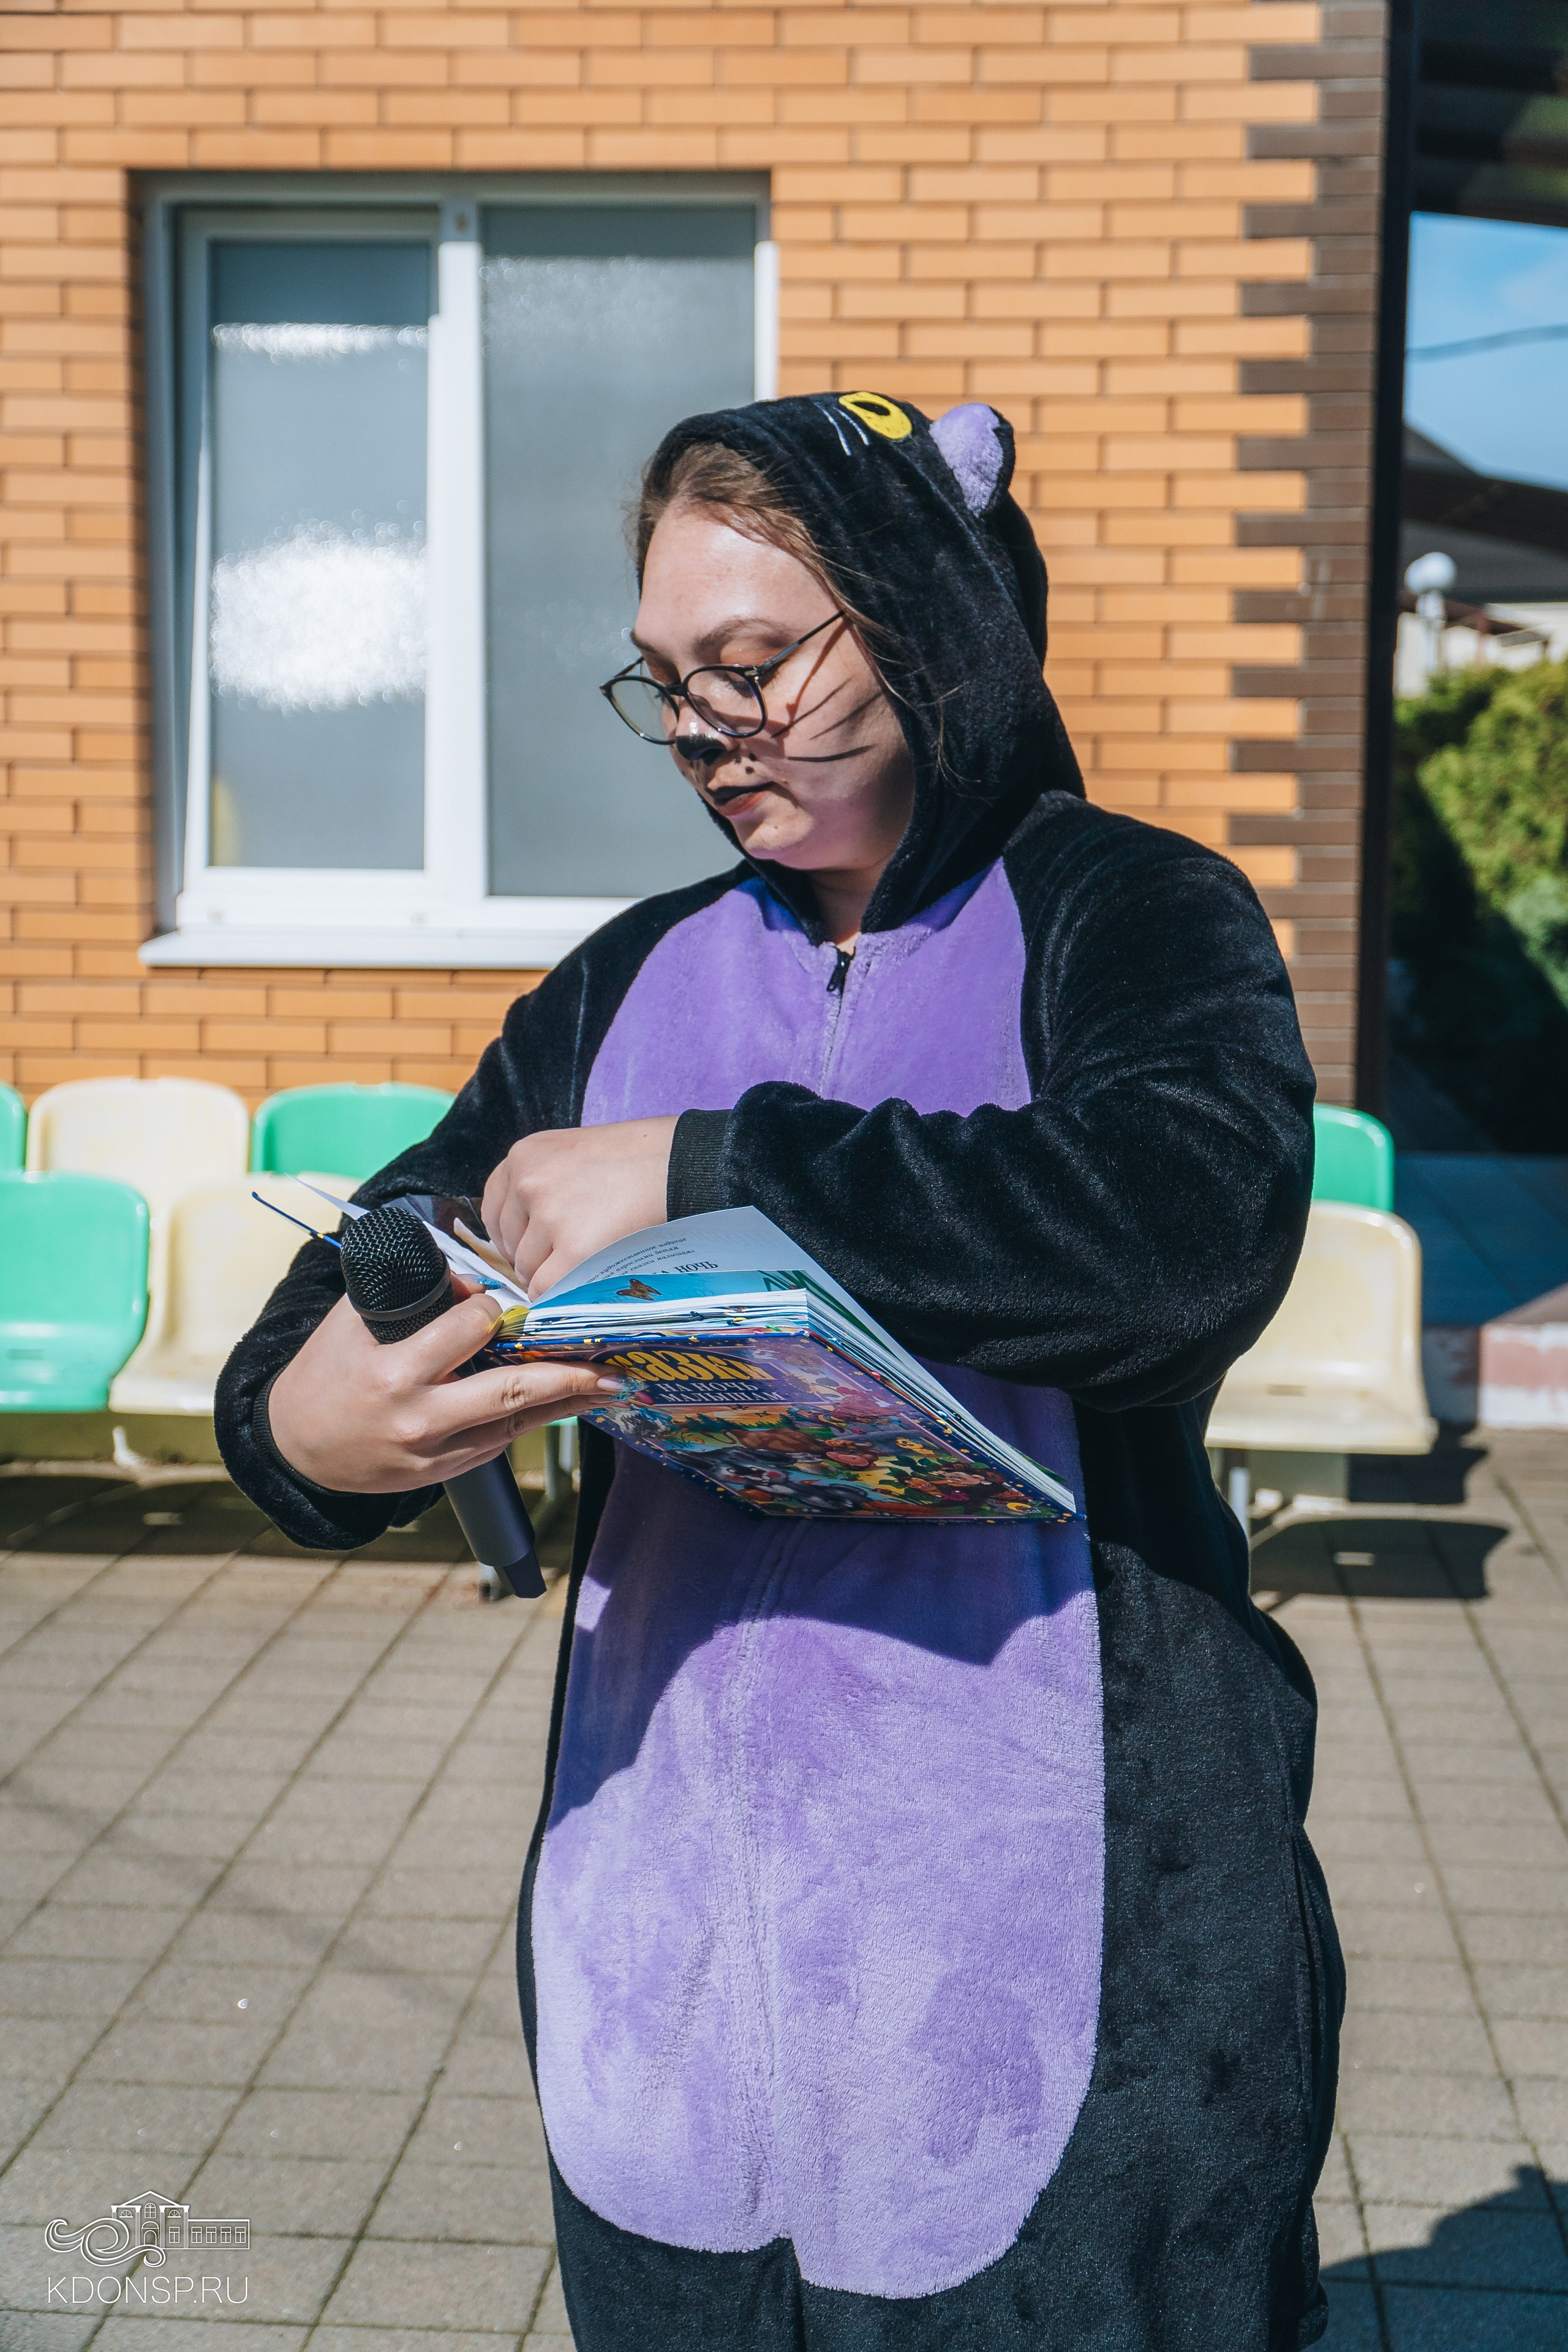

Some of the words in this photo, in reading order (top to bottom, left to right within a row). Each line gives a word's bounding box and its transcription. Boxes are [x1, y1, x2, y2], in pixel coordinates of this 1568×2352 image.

[658, 1238, 687, 1246] издание
[616, 1254, 653, 1272] взрослыми
[630, 1260, 655, 1271] сказки
[673, 1261, 718, 1273] НОЧЬ
[605, 1350, 778, 1382] казки
[654, 1382, 693, 1392] НА
[693, 1382, 759, 1392] НОЧЬ
[658, 1392, 787, 1402] МАЛЫШАМ
